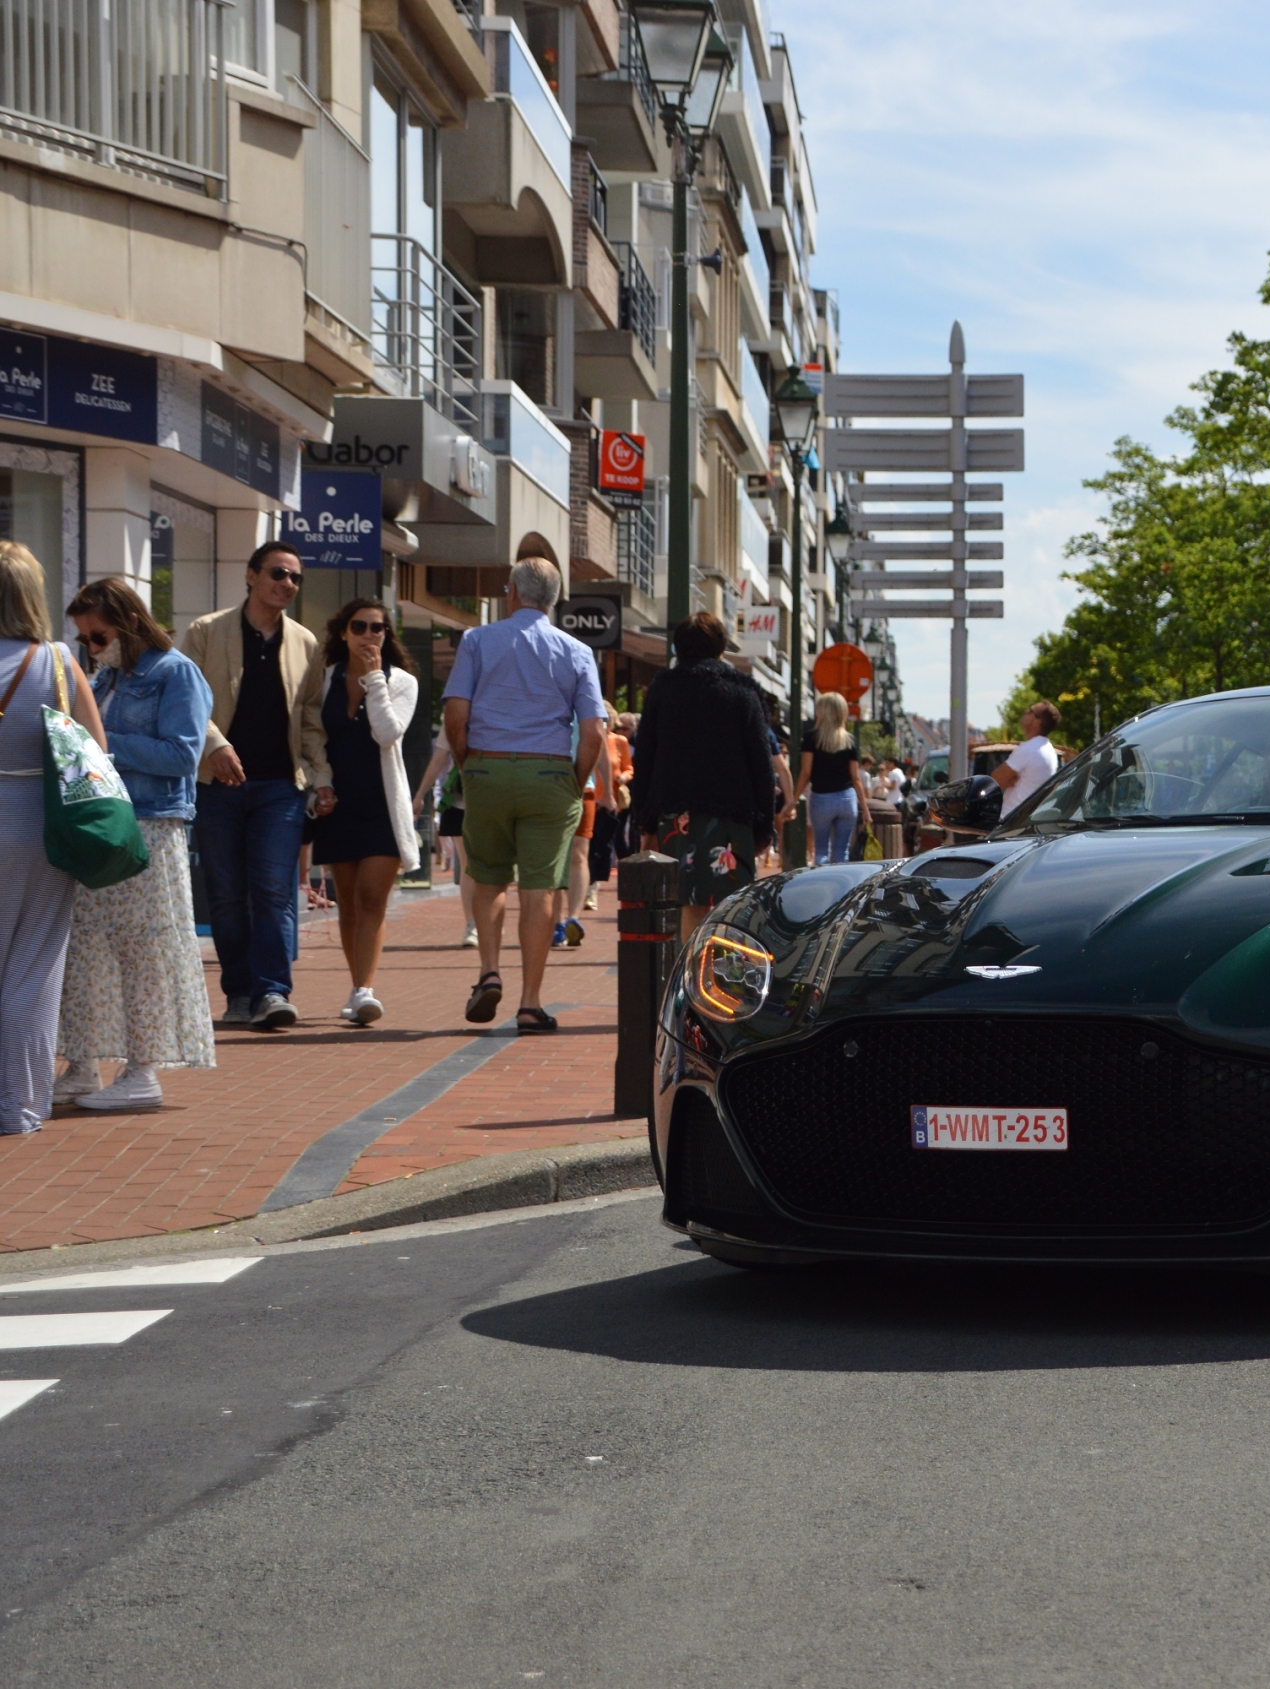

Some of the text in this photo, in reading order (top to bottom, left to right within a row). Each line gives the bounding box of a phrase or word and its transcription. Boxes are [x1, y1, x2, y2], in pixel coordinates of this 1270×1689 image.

[11, 367, 42, 390] Perle
[91, 373, 116, 394] ZEE
[74, 392, 132, 412] DELICATESSEN
[307, 435, 410, 465] Gabor
[288, 511, 374, 534] la Perle
[304, 532, 360, 543] DES DIEUX
[562, 614, 616, 629] ONLY
[748, 614, 777, 632] H&M
[916, 1130, 926, 1143] B
[928, 1113, 1066, 1143] 1-WMT-253
